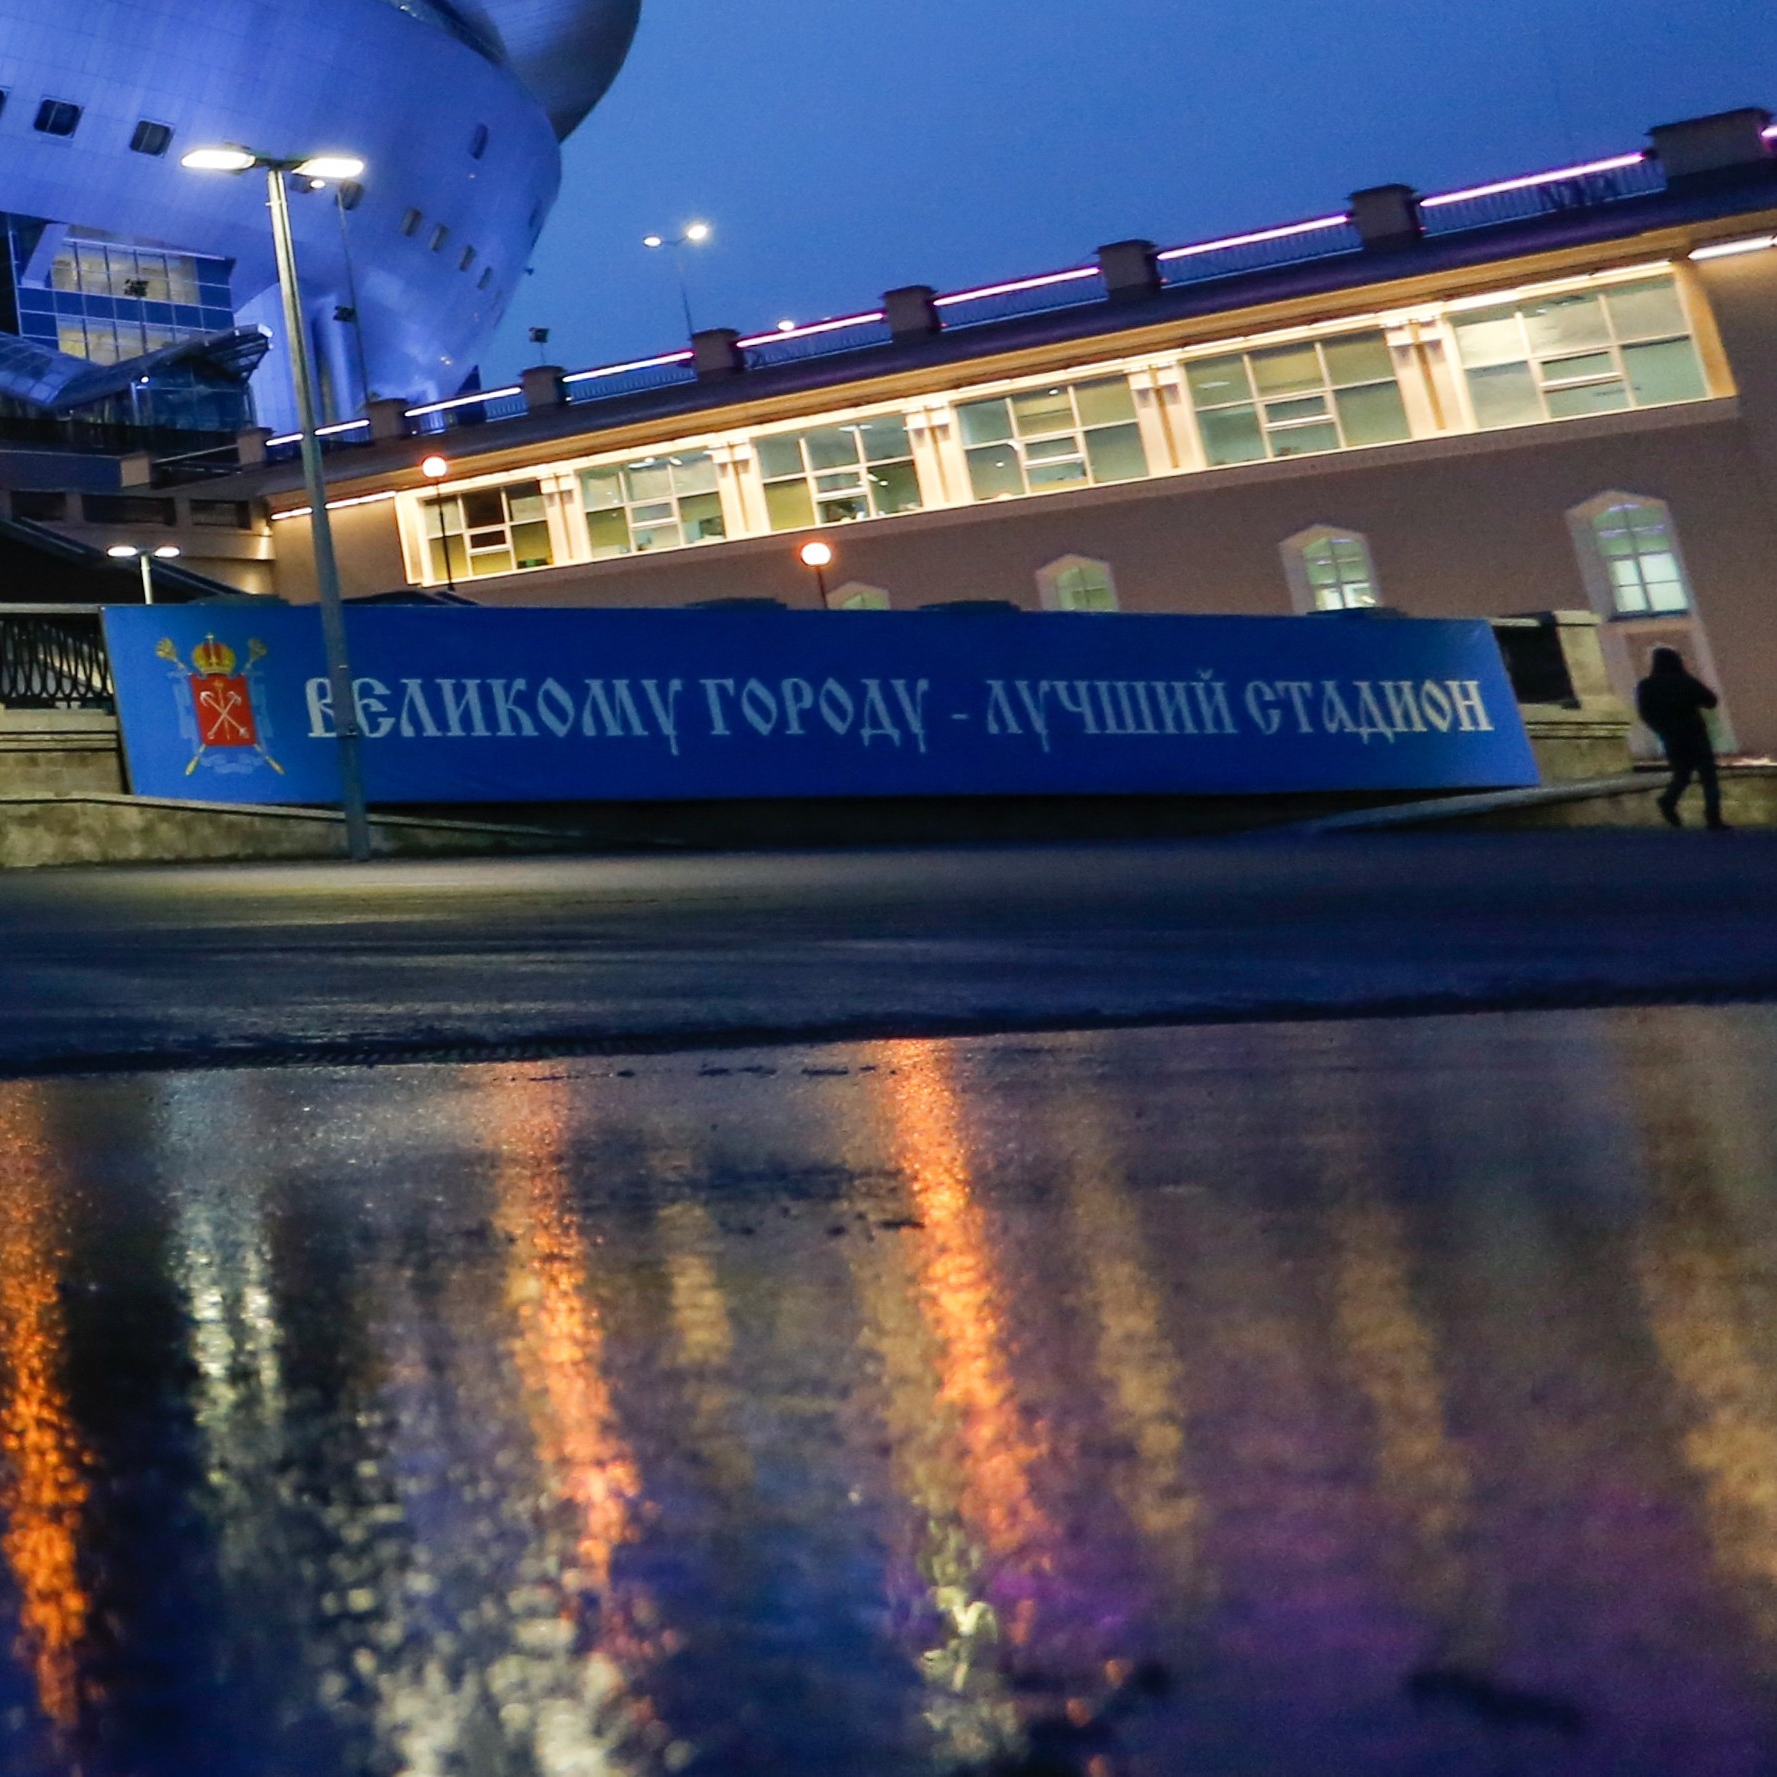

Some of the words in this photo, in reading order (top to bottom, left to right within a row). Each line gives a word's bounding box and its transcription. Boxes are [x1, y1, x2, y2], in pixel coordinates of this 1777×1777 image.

[305, 677, 683, 755] ВЕЛИКОМУ
[698, 678, 928, 753] ГОРОДУ
[986, 670, 1237, 752] ЛУЧШИЙ
[1247, 679, 1494, 744] СТАДИОН
